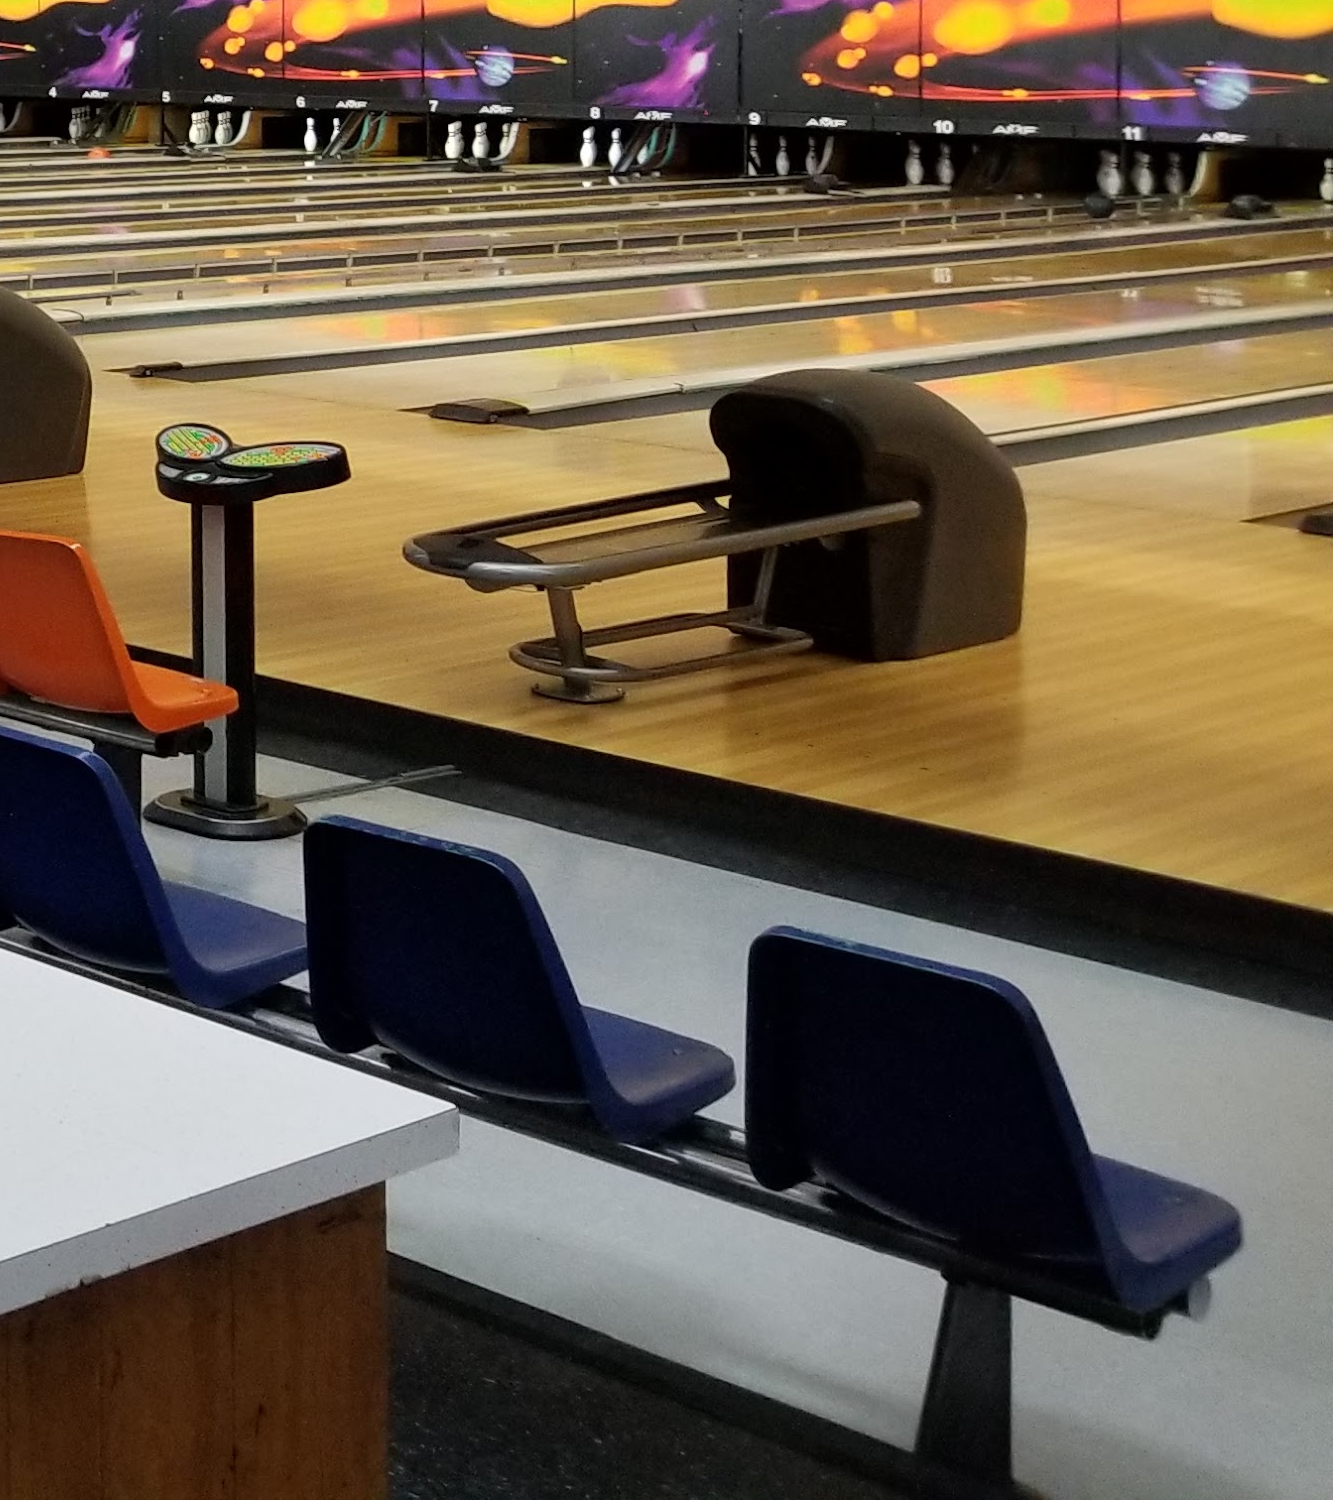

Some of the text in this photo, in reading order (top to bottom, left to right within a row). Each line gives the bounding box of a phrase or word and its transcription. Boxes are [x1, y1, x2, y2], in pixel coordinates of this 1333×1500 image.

[48, 87, 57, 98] 4
[162, 91, 171, 103] 5
[296, 96, 305, 108] 6
[335, 99, 368, 110] AMF
[429, 100, 438, 112] 7
[478, 104, 514, 115] AMF
[590, 107, 600, 119] 8
[634, 110, 672, 121] AMF
[748, 112, 761, 125] 9
[805, 116, 848, 127] AMF
[933, 119, 954, 134] 10
[992, 123, 1039, 135] AMF
[1122, 125, 1142, 141] 11
